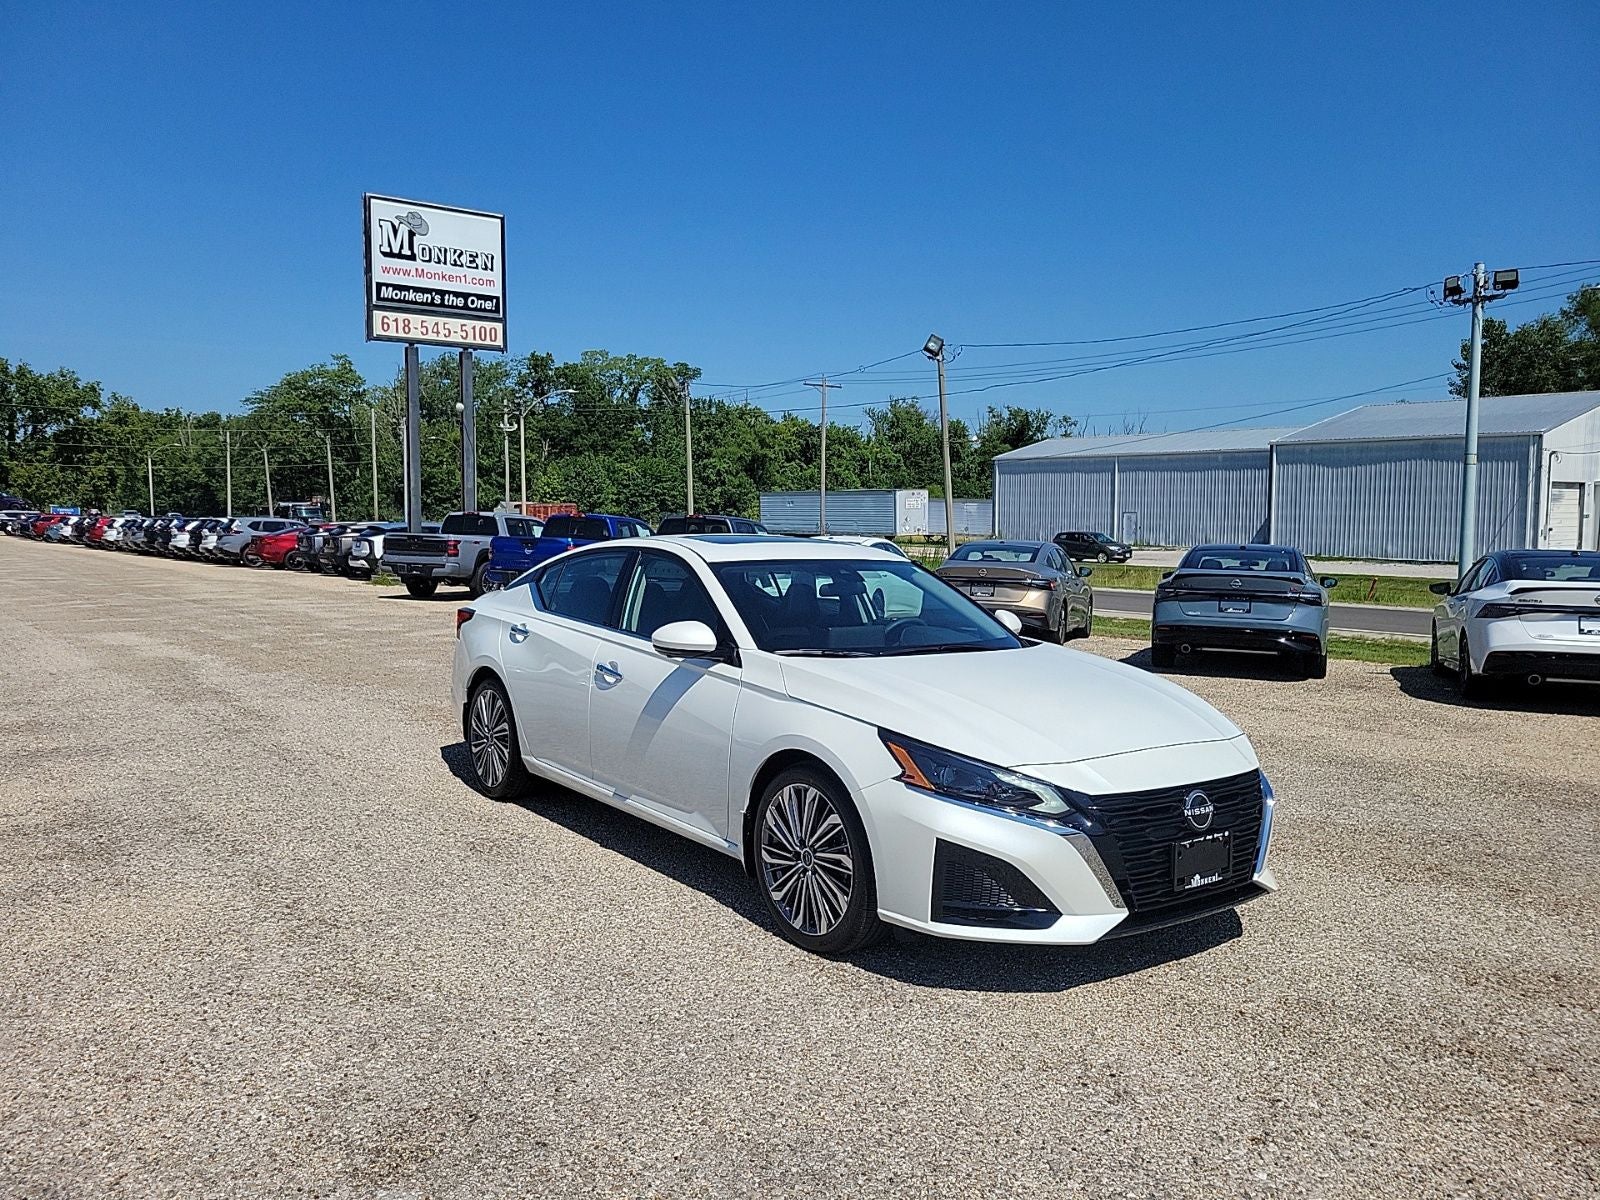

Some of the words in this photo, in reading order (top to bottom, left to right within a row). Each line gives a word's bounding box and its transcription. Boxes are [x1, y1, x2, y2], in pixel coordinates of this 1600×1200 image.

[379, 218, 495, 272] MONKEN
[381, 265, 496, 287] www.Monken1.com
[380, 286, 441, 304] Monken's
[444, 293, 464, 307] the
[467, 296, 496, 310] One!
[381, 315, 498, 343] 618-545-5100
[1184, 804, 1214, 816] NISSAN
